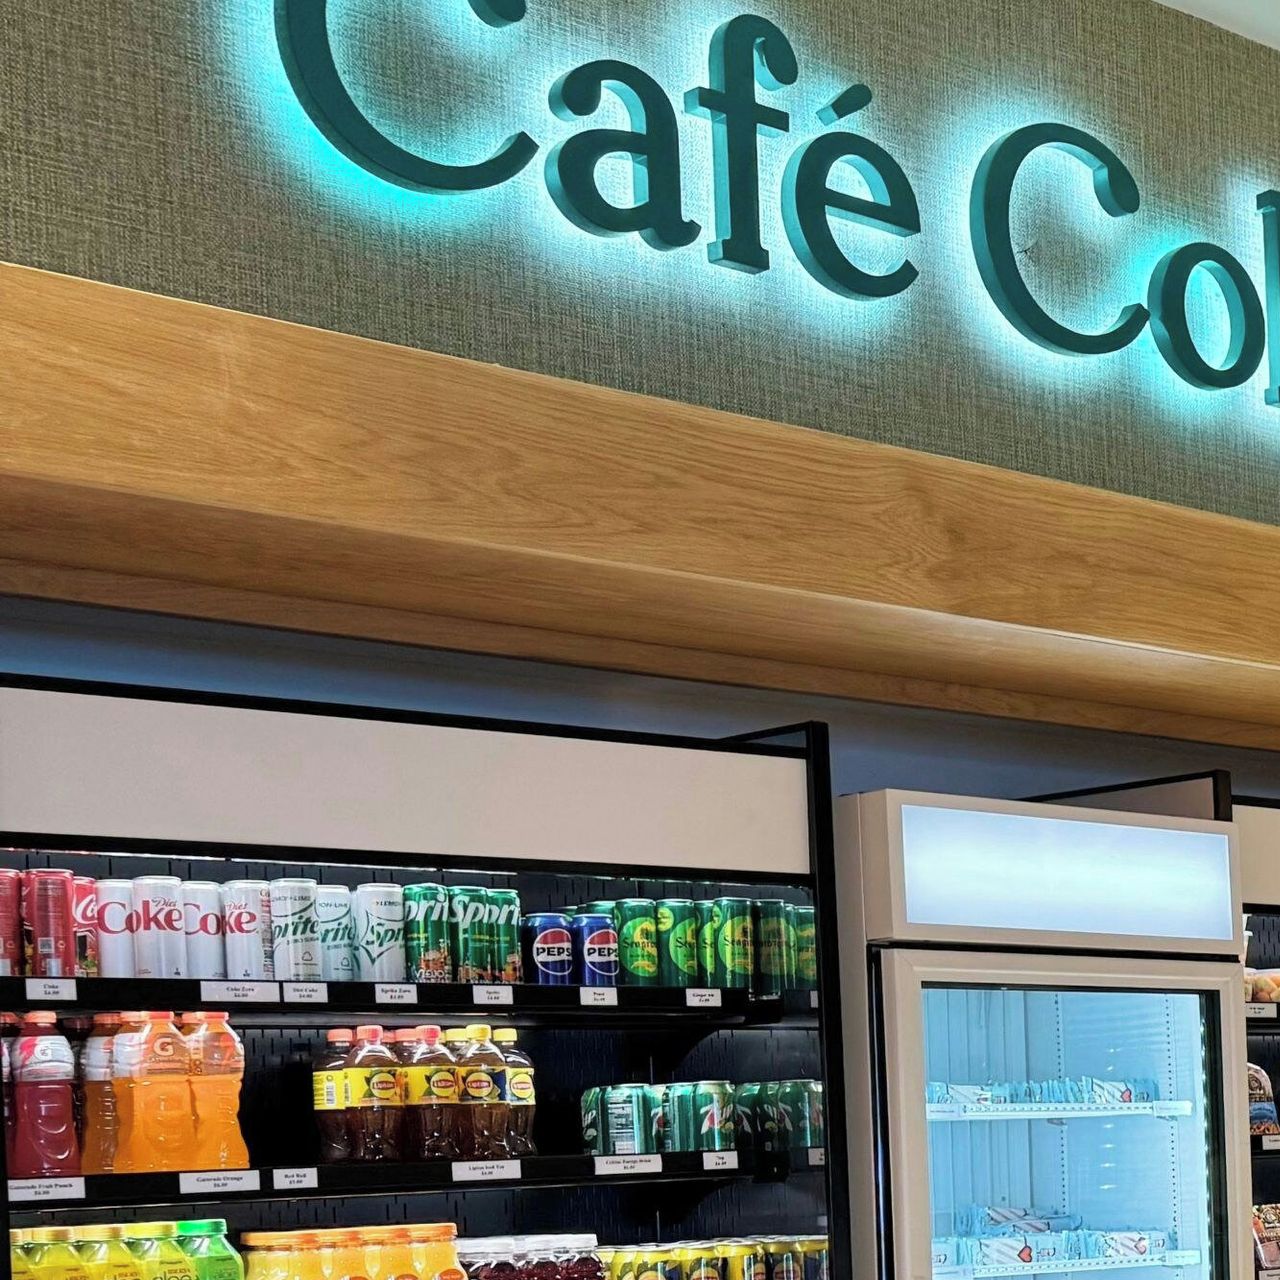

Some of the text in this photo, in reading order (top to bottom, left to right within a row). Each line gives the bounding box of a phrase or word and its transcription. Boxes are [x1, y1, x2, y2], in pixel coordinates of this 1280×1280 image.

[272, 0, 922, 302] Café
[536, 946, 572, 957] PEPS
[587, 946, 618, 957] PEPS
